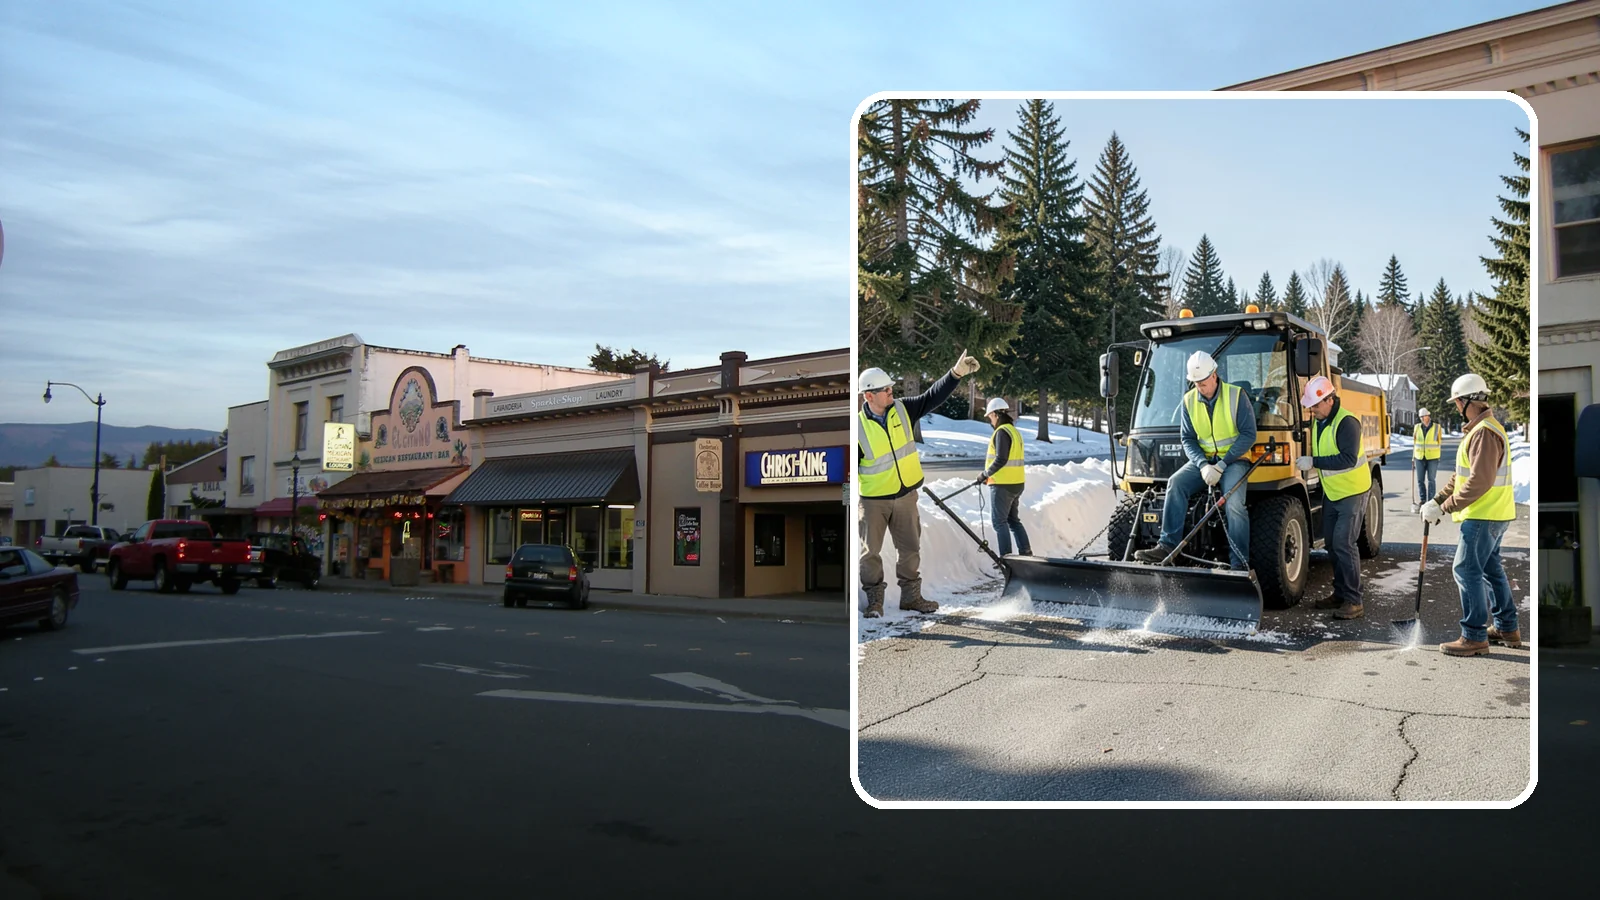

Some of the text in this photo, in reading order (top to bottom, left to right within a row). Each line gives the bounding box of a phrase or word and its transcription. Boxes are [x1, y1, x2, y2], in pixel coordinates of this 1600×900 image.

[561, 394, 582, 405] Shop
[595, 389, 624, 400] LAUNDRY
[493, 401, 523, 413] LAVANDERIA
[373, 454, 396, 464] MEXICAN
[397, 451, 433, 462] RESTAURANT
[438, 450, 450, 459] BAR
[761, 450, 827, 478] CHRIST KING
